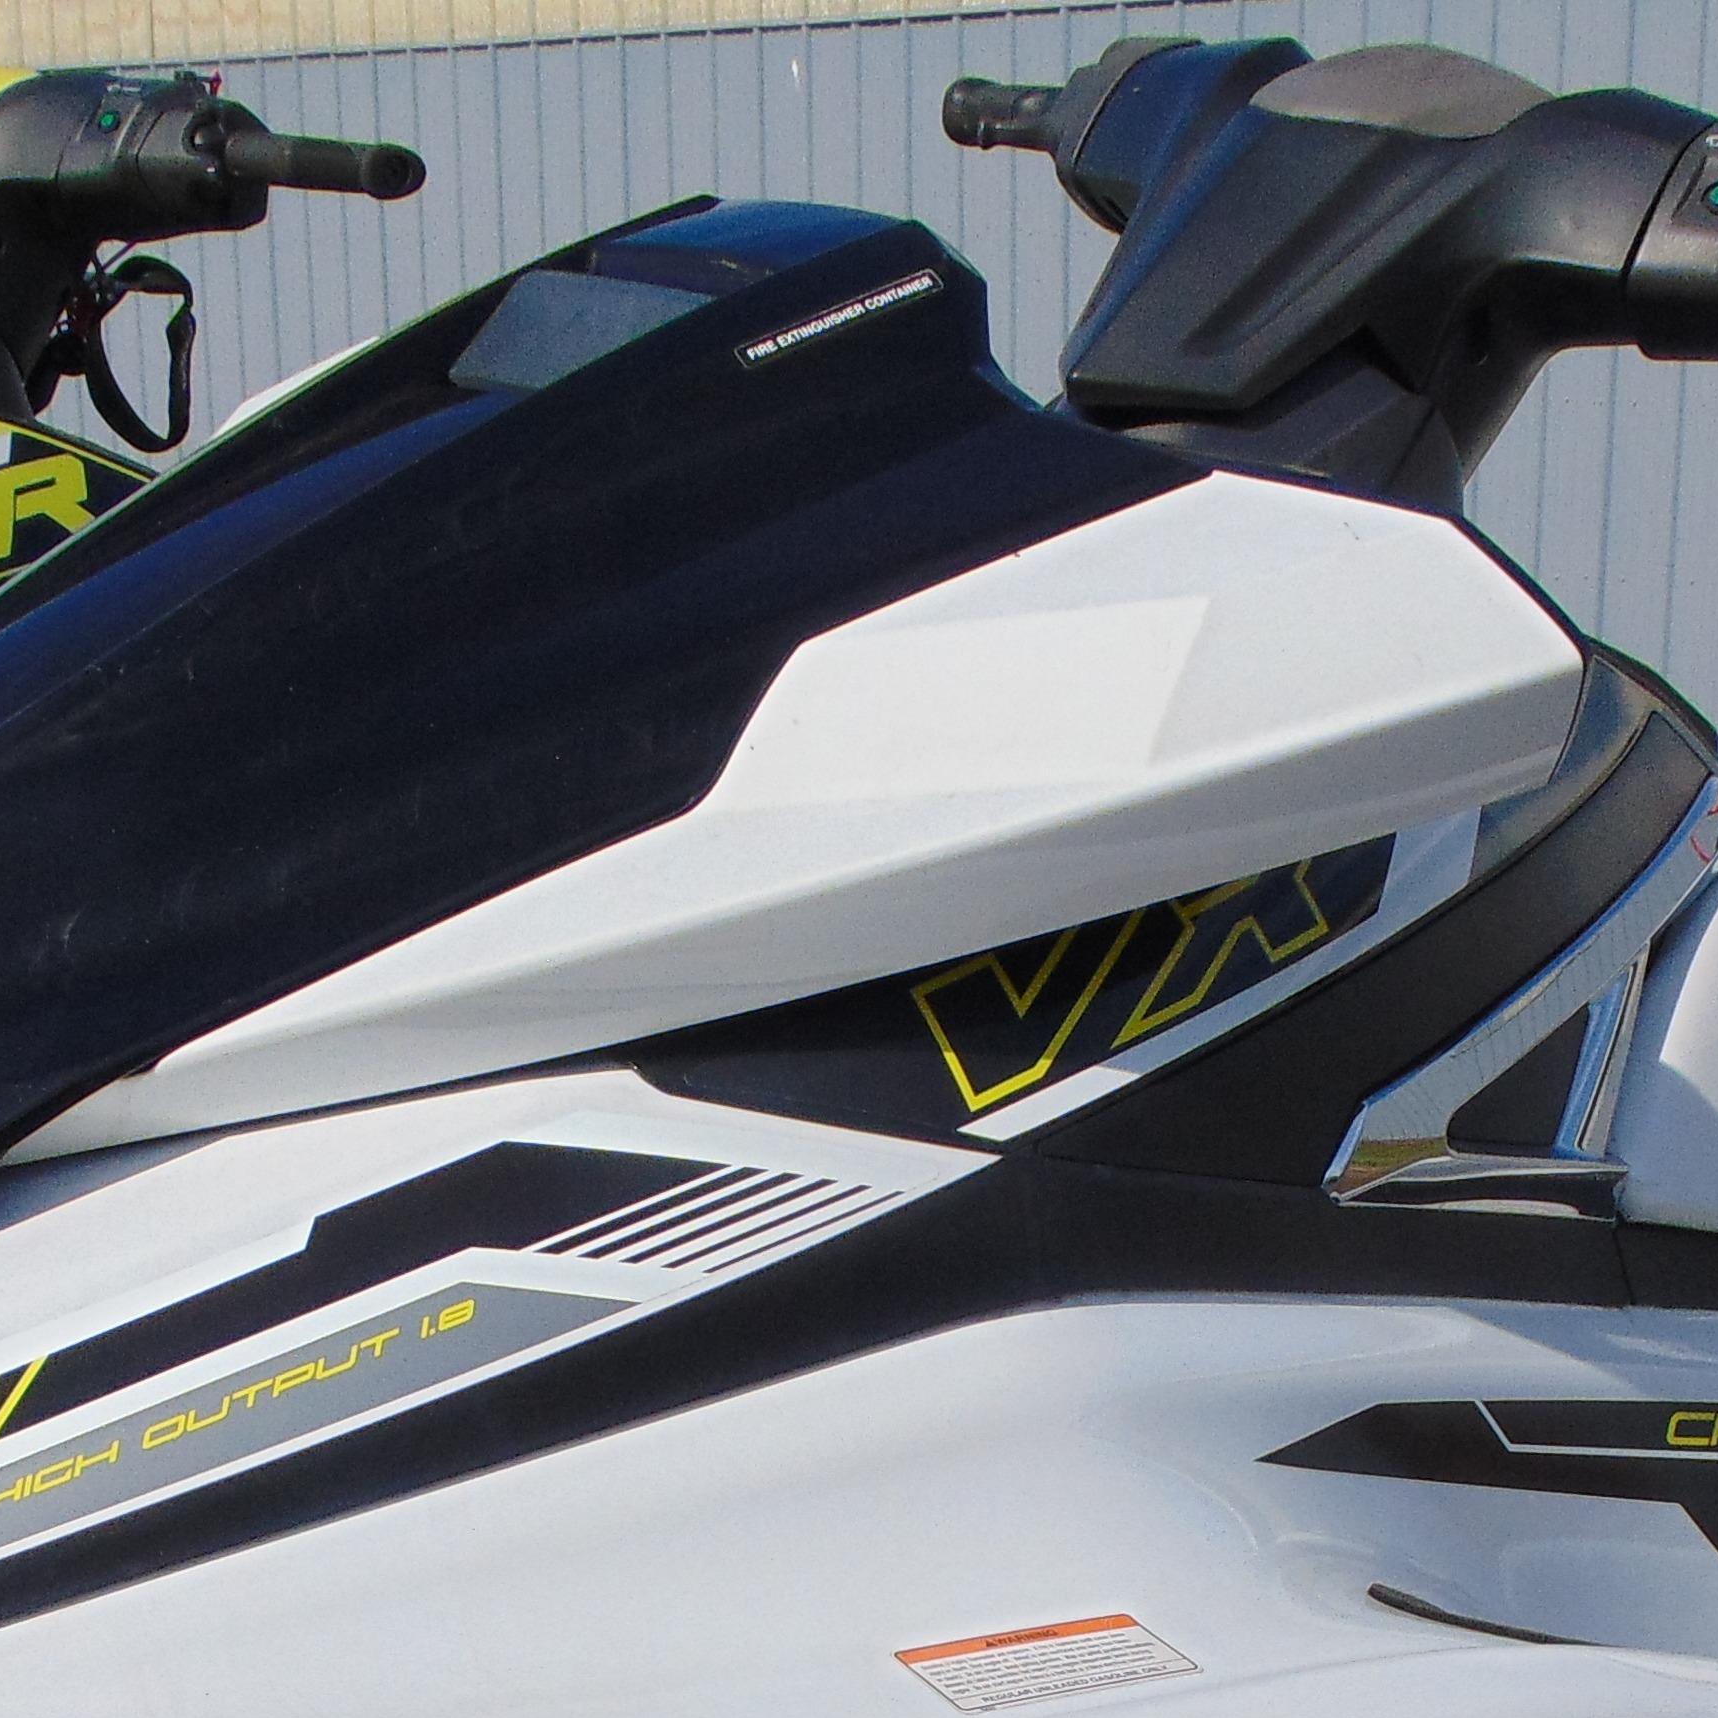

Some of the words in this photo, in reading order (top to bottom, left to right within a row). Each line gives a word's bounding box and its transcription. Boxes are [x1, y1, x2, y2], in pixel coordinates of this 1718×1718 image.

[747, 340, 778, 360] FIRE
[777, 303, 865, 347] EXTINGUISHER
[865, 276, 933, 310] CONTAINER
[141, 1328, 400, 1450] OUTPUT
[420, 1299, 476, 1339] 1.8
[996, 1629, 1058, 1646] WARNING
[981, 1689, 1033, 1703] REGULAR
[1088, 1669, 1140, 1683] GASOLINE
[1141, 1664, 1168, 1674] ONLY
